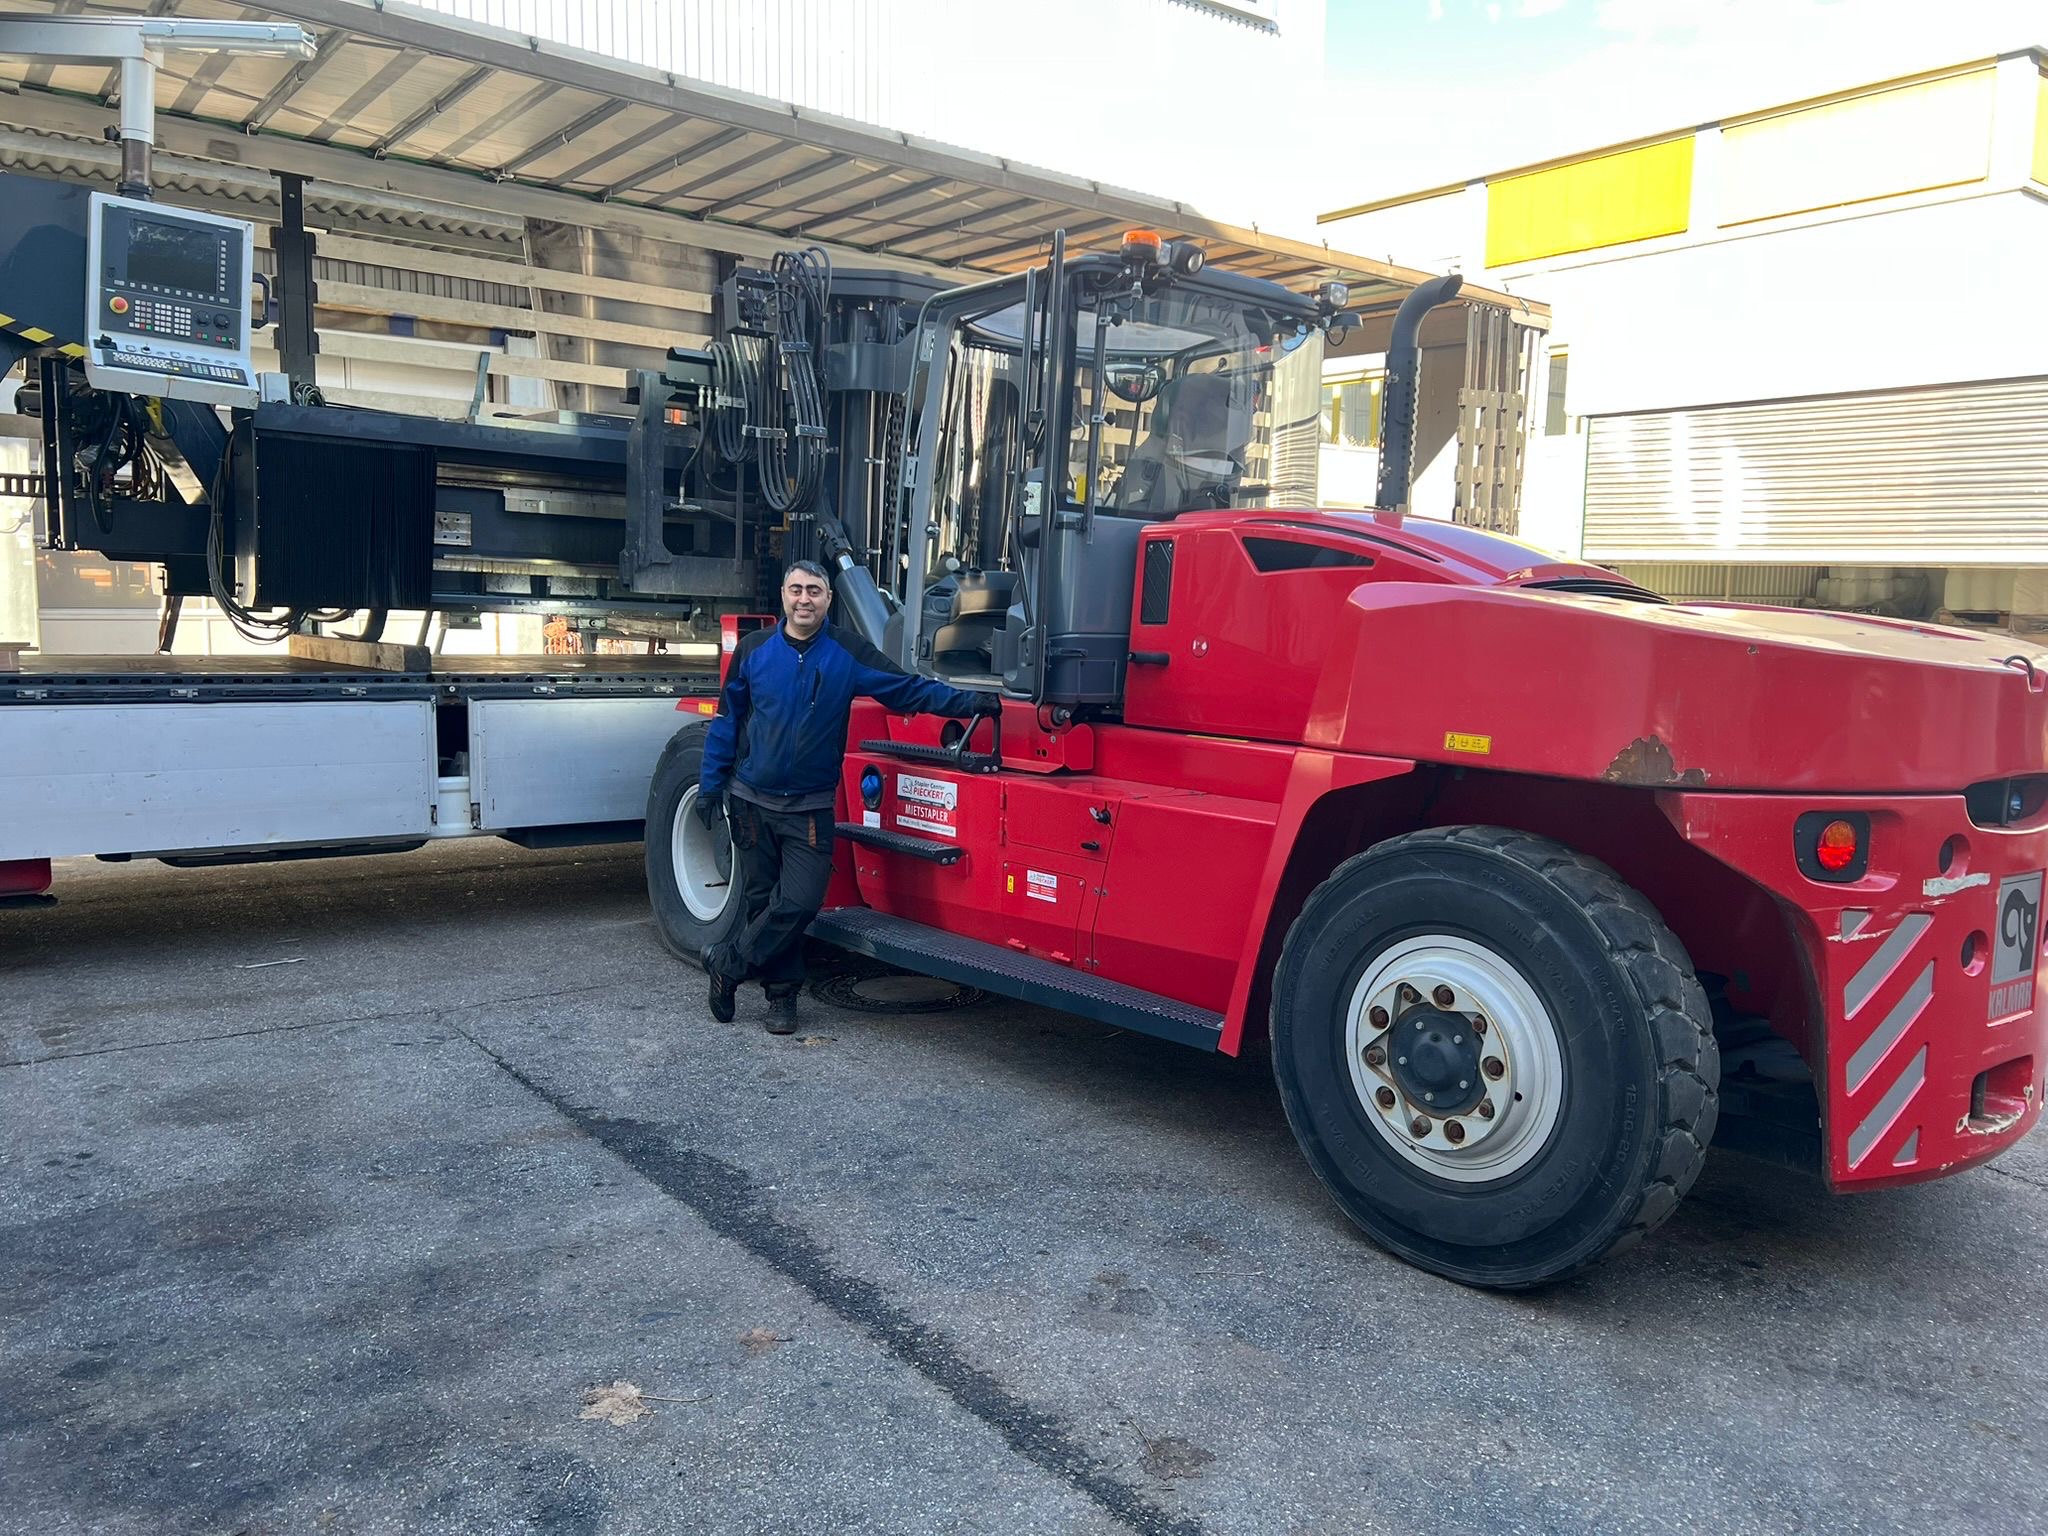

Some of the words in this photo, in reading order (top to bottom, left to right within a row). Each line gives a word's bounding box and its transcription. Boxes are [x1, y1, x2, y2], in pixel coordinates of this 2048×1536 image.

[913, 787, 944, 800] PIECKERT
[905, 804, 948, 823] MIETSTAPLER
[1988, 981, 2033, 1020] KALMAR
